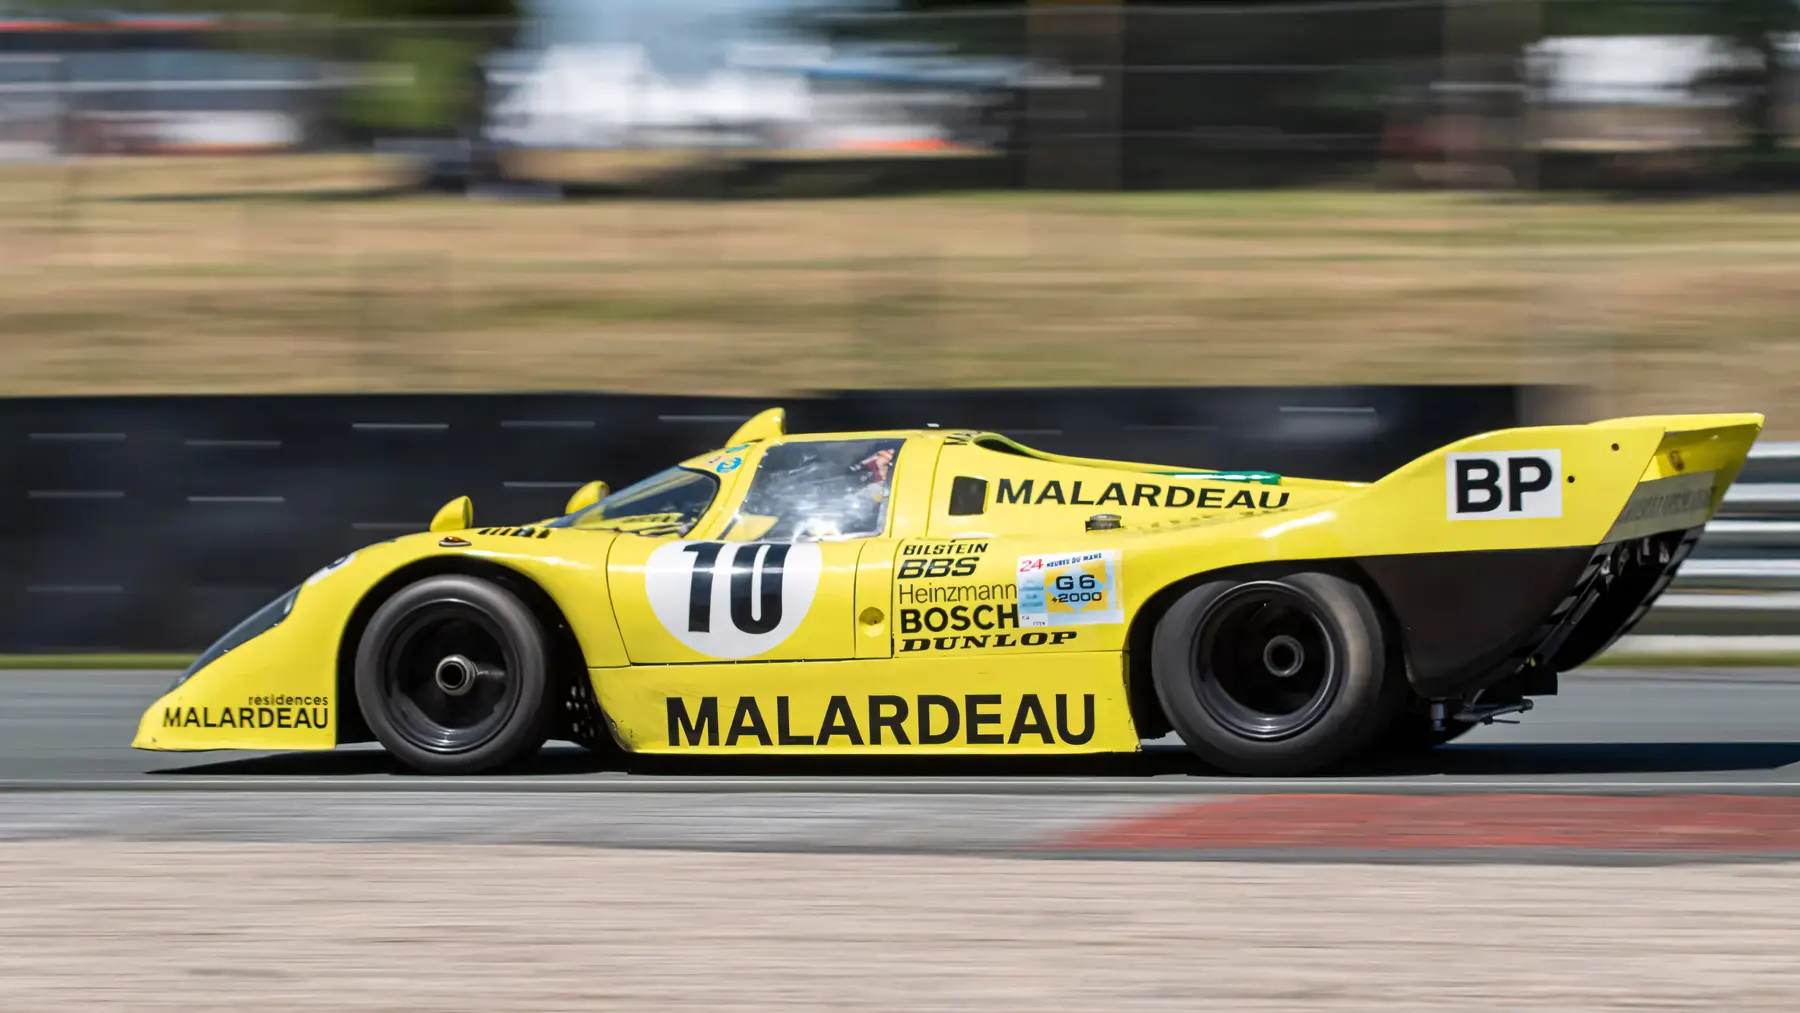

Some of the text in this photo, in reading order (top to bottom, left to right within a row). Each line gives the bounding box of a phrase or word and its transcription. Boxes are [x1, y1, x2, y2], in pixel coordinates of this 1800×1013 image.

[996, 478, 1290, 509] MALARDEAU
[1455, 456, 1552, 513] BP
[903, 543, 988, 555] BILSTEIN
[897, 557, 980, 579] BBS
[1019, 558, 1044, 572] 24
[682, 542, 792, 634] 10
[899, 582, 1018, 604] Heinzmann
[900, 604, 1020, 634] BOSCH
[899, 631, 1077, 652] DUNLOP
[163, 707, 328, 729] MALARDEAU
[666, 693, 1096, 747] MALARDEAU
